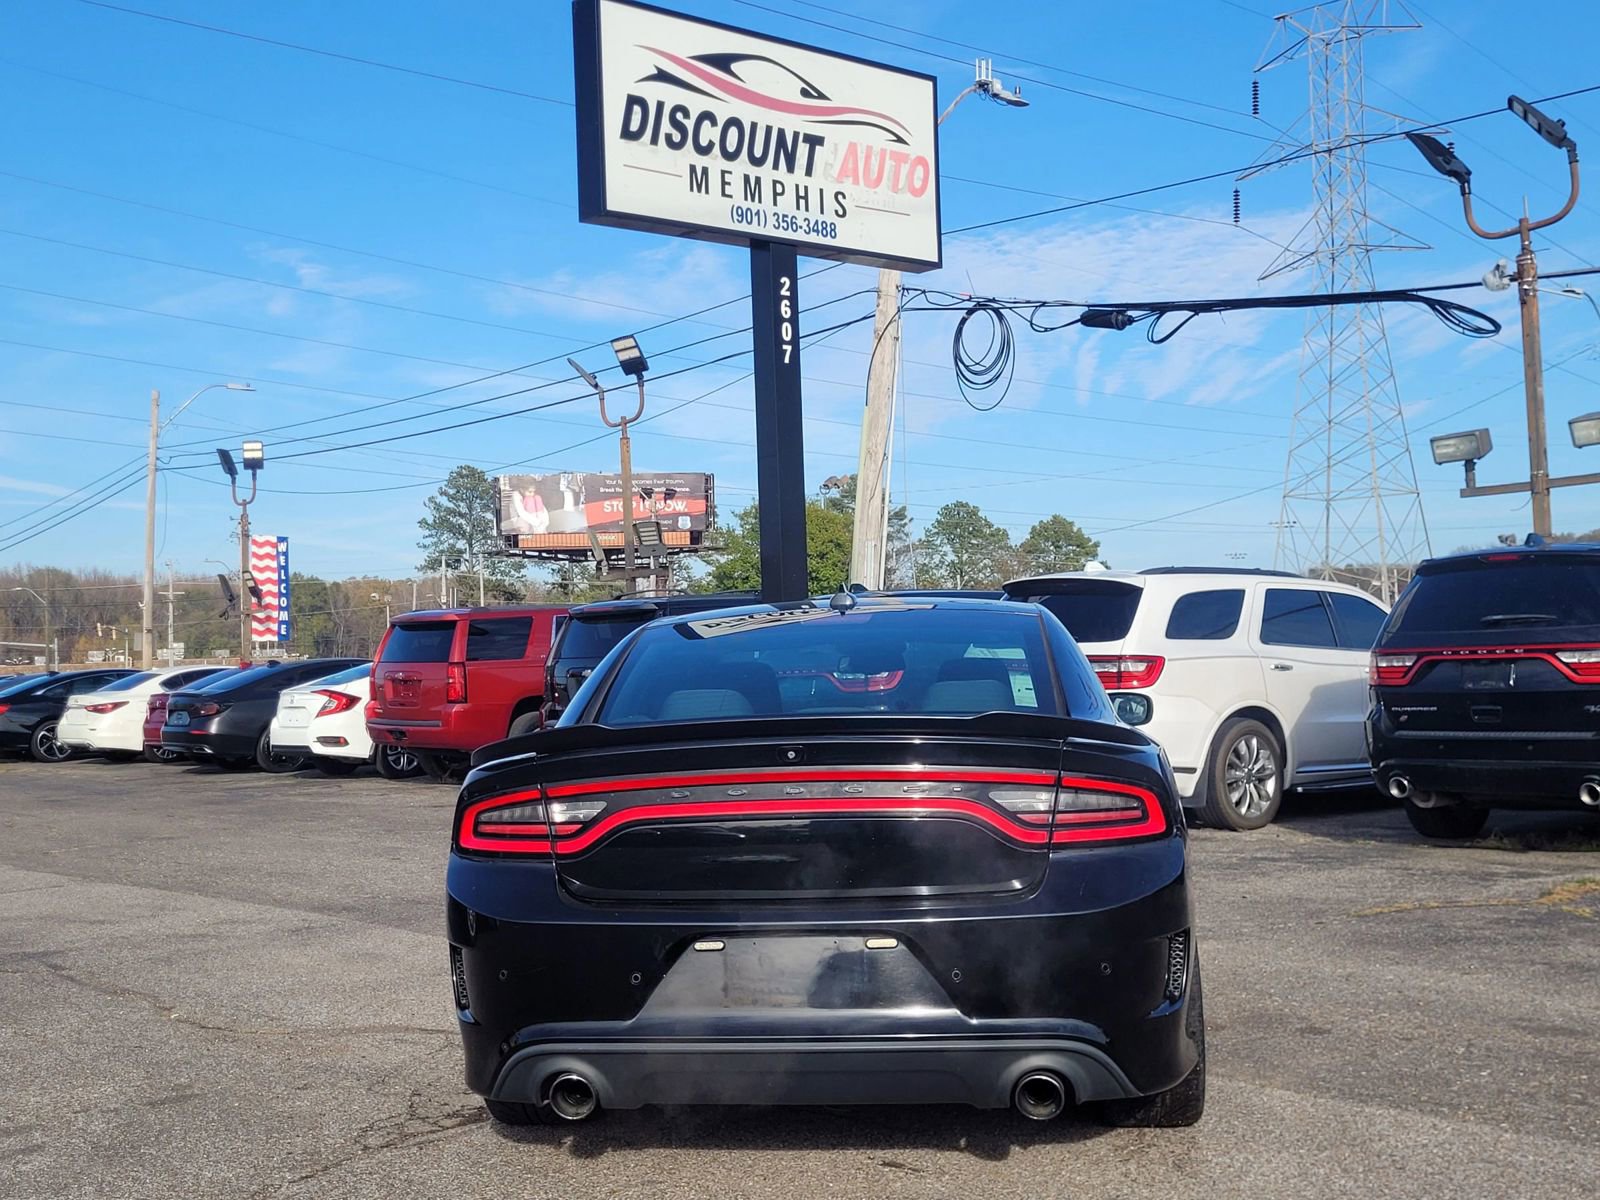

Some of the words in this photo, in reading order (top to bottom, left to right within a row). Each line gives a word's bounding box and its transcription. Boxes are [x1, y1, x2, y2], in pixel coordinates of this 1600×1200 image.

[620, 94, 825, 178] DISCOUNT
[836, 141, 930, 198] AUTO
[689, 164, 847, 219] MEMPHIS
[730, 204, 768, 230] (901)
[773, 212, 838, 240] 356-3488
[780, 276, 792, 364] 2607
[277, 542, 289, 635] WELCOME
[671, 784, 928, 798] DODGE
